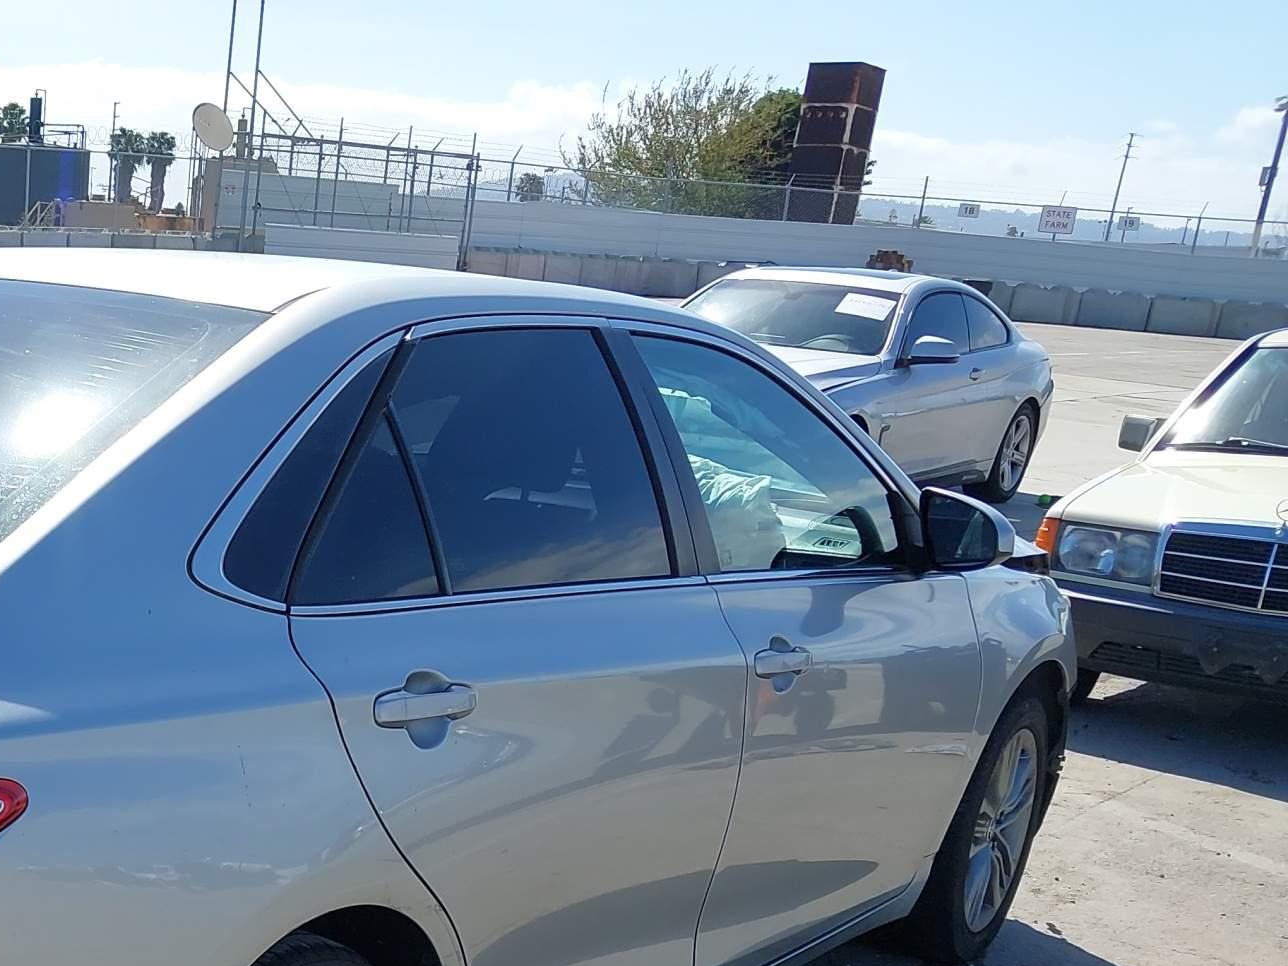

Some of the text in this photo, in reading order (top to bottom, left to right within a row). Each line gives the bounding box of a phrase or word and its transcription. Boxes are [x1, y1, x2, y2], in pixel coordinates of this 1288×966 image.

[964, 206, 975, 215] 18
[1046, 210, 1073, 219] STATE
[1045, 221, 1069, 229] FARM
[1124, 219, 1135, 228] 19
